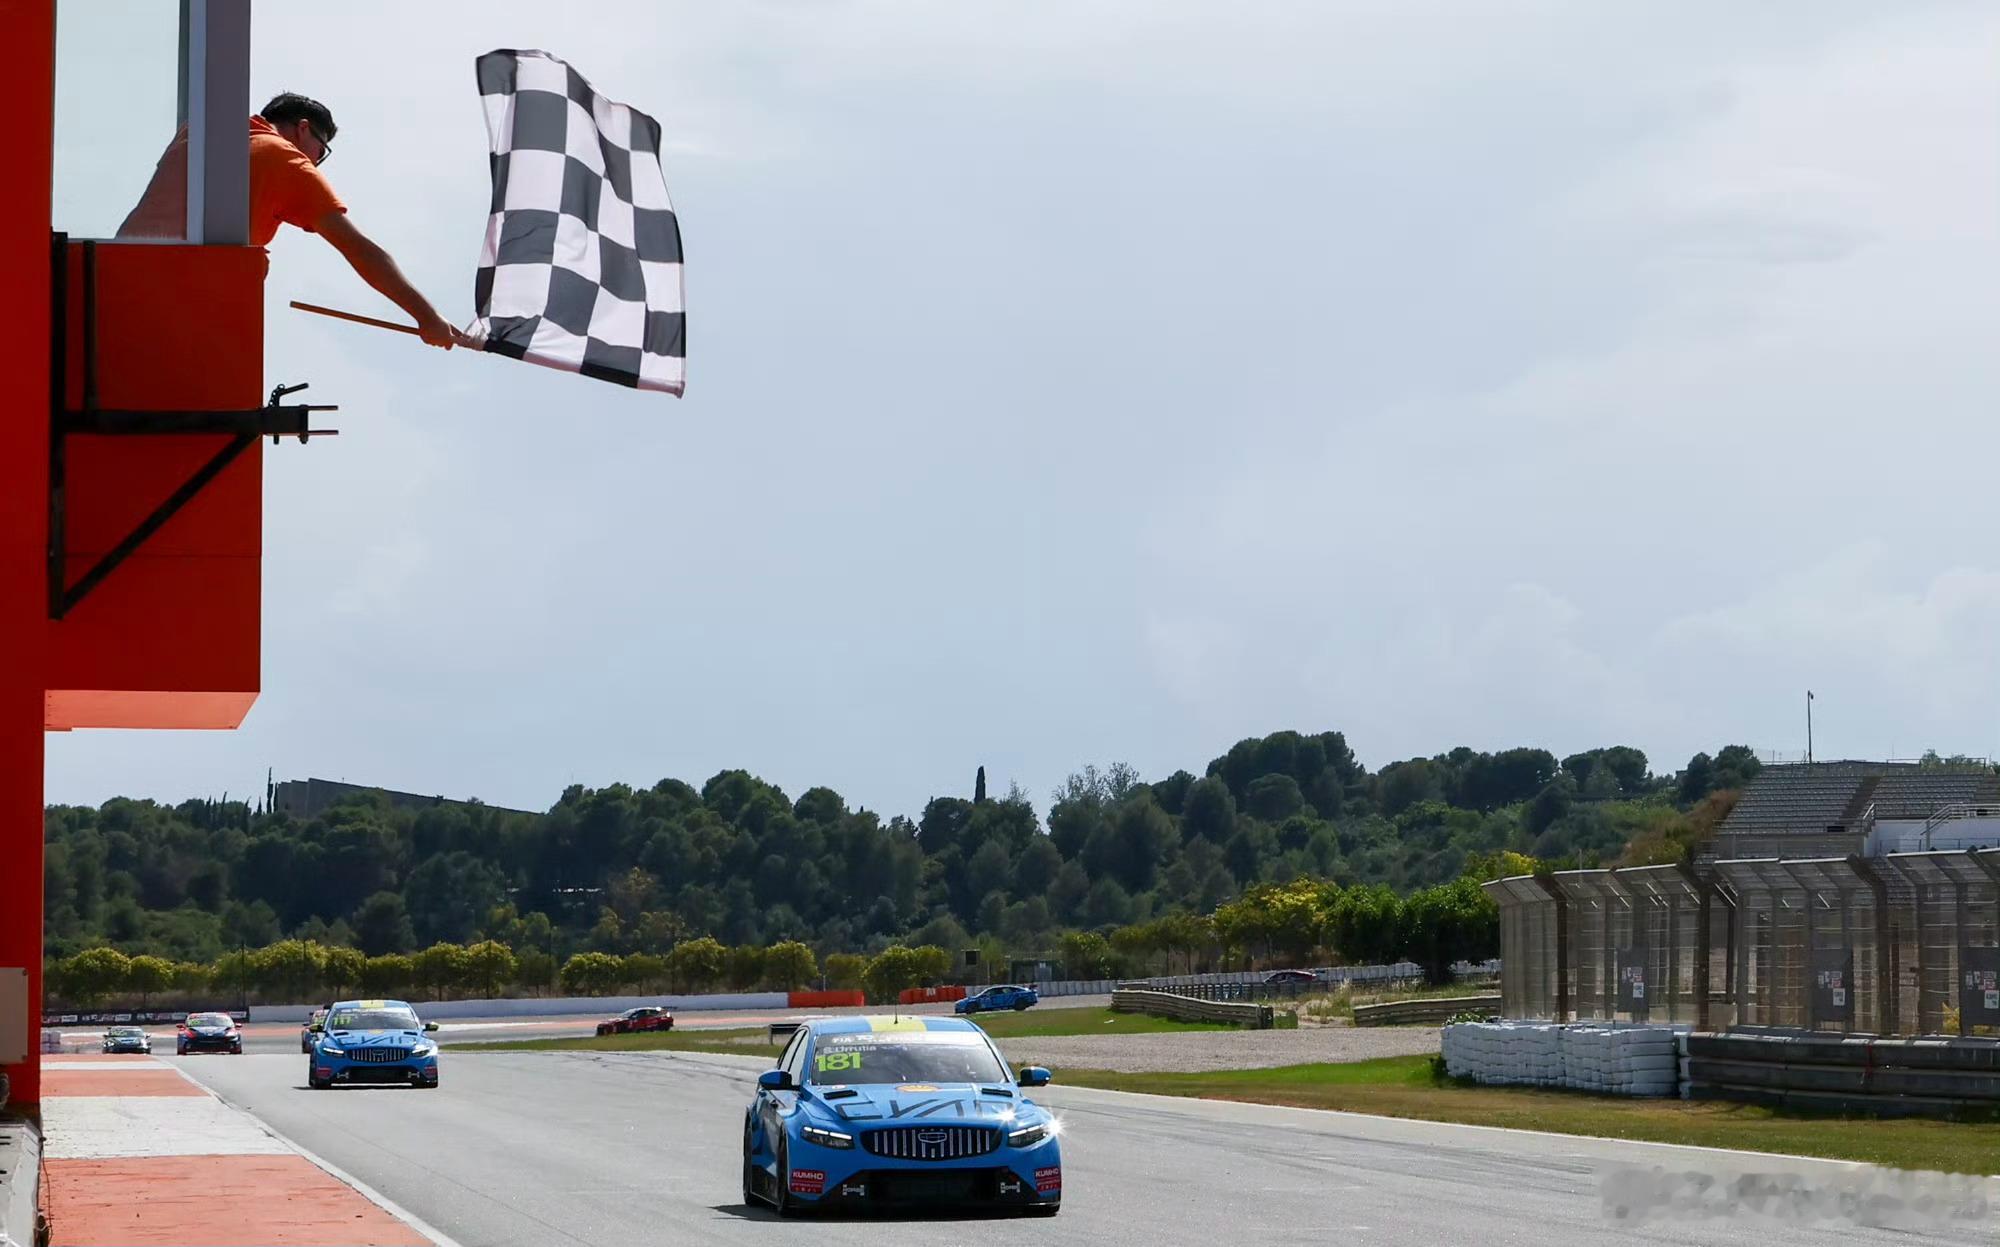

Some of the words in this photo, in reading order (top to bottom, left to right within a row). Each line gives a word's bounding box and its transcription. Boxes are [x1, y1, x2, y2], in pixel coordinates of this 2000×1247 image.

[816, 1052, 861, 1072] 181
[792, 1171, 824, 1180] KUMHO
[1035, 1168, 1059, 1177] KUMHO
